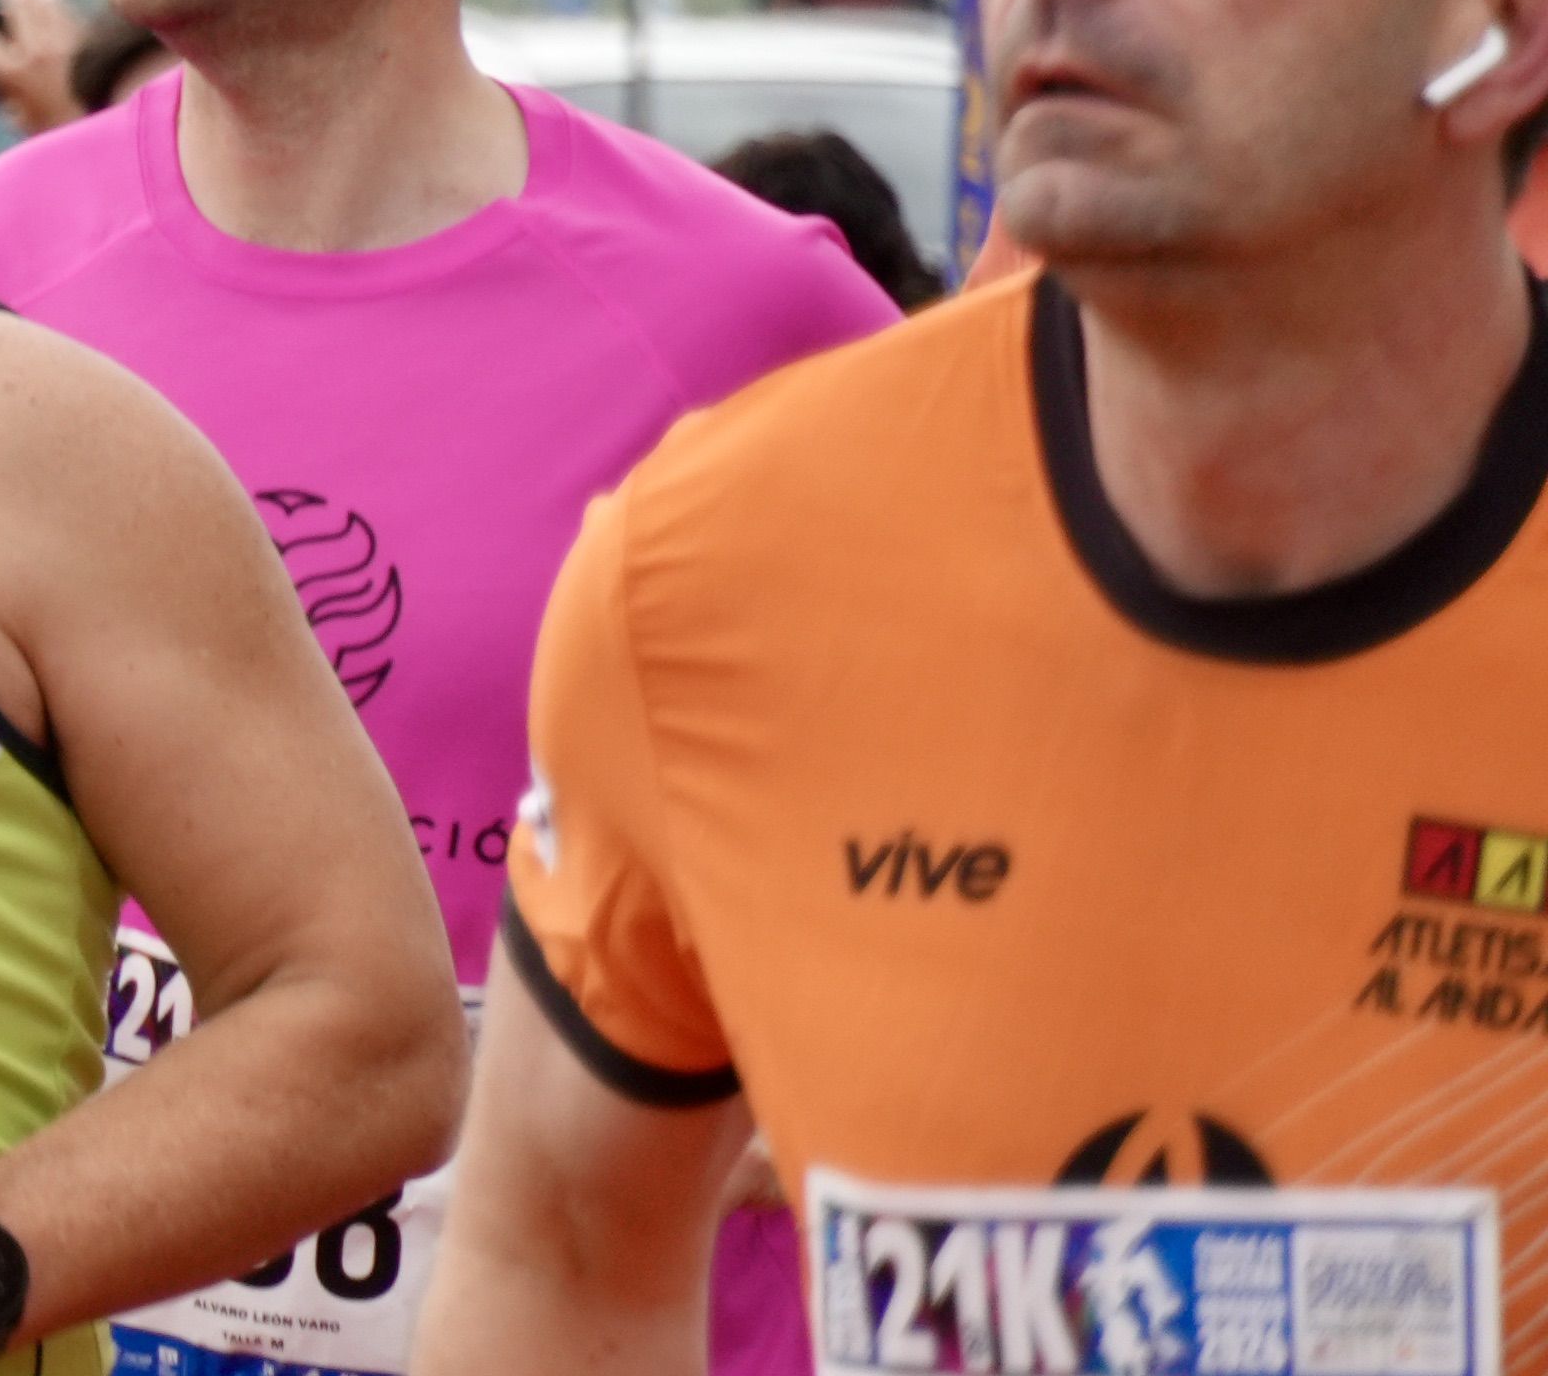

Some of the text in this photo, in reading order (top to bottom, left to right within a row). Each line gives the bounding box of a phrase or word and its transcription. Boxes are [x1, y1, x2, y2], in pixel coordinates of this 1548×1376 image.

[845, 830, 1010, 903] vive
[1370, 911, 1548, 978] ATLETIS
[194, 1298, 248, 1320] ALVARO
[253, 1309, 293, 1330] LEÓN
[864, 1219, 1078, 1376] 21K
[270, 1338, 285, 1352] M
